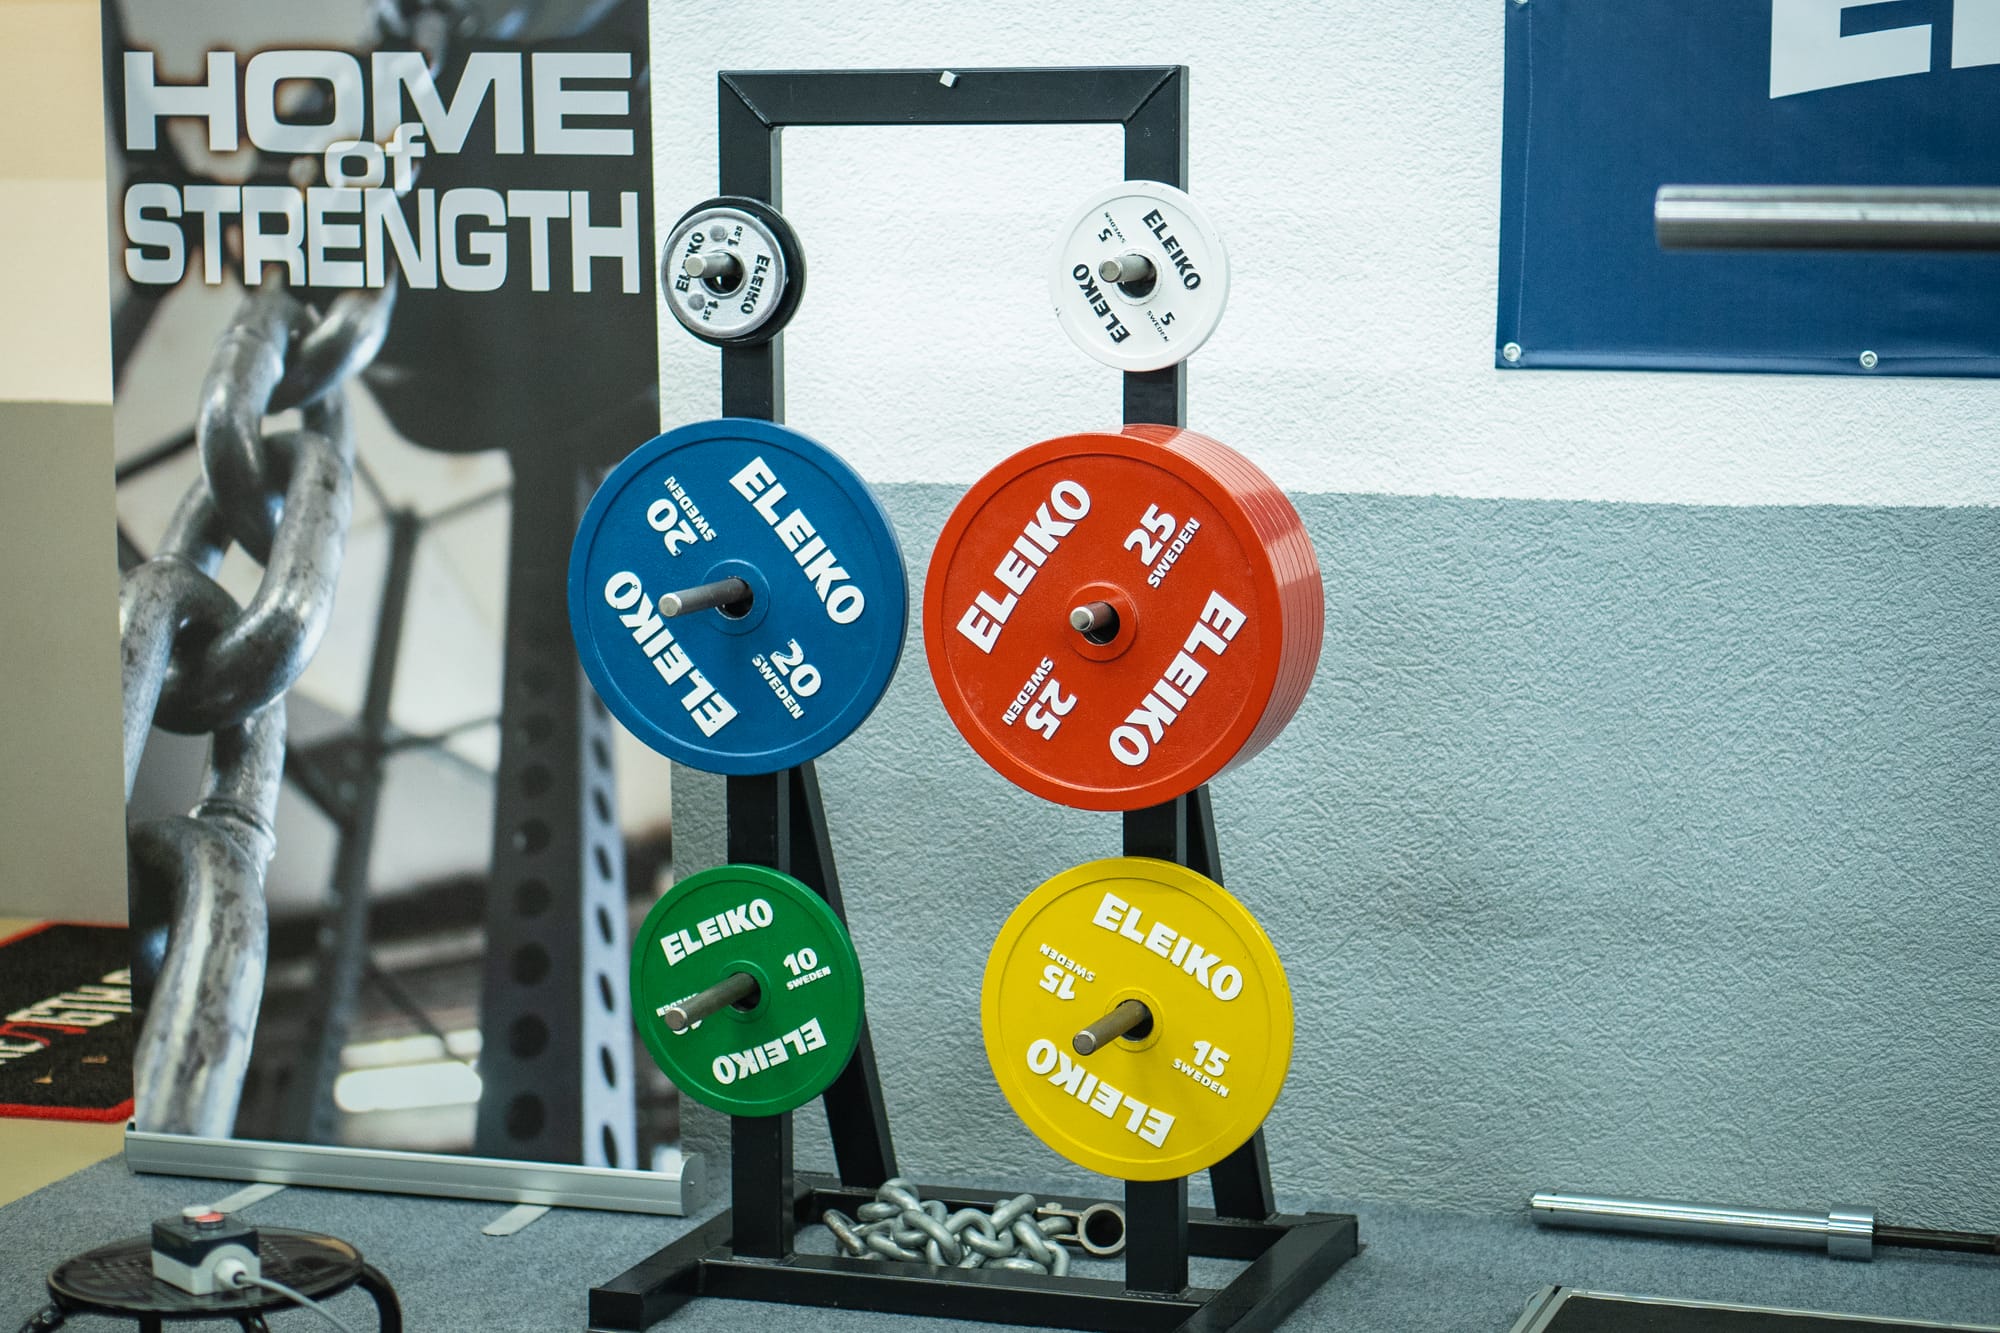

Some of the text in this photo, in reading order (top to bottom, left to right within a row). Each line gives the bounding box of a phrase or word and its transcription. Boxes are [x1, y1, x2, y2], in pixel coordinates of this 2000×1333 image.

[123, 50, 634, 155] HOME
[324, 122, 426, 191] of
[124, 182, 640, 294] STRENGTH
[1098, 228, 1113, 243] 5
[1104, 211, 1126, 244] SWEDEN
[1142, 208, 1202, 290] ELEIKO
[675, 232, 705, 292] ELKO
[740, 254, 771, 314] ELEIKO
[1072, 263, 1132, 344] ELEIKO
[1147, 310, 1169, 342] SWEDEN
[1160, 311, 1176, 326] 5
[646, 498, 699, 557] 20
[664, 475, 717, 543] SWEDEN
[728, 455, 865, 625] ELEIKO
[1123, 503, 1177, 567] 25
[956, 480, 1092, 654] ELEIKO
[1147, 517, 1201, 589] SWEDEN
[604, 570, 740, 738] ELEIKO
[751, 653, 805, 720] SWEDEN
[769, 638, 822, 697] 20
[1108, 590, 1247, 767] ELEIKO
[1002, 657, 1054, 726] SWEDEN
[1025, 678, 1078, 741] 25
[659, 898, 774, 967] ELEIKO
[783, 947, 818, 976] 10
[1039, 943, 1096, 983] SWEDEN
[1092, 892, 1244, 1001] ELEIKO
[786, 965, 832, 991] SWEDEN
[1039, 964, 1076, 1000] 15
[712, 1017, 828, 1085] ELEIKO
[1171, 1058, 1229, 1098] SWEDEN
[1192, 1040, 1231, 1077] 15
[1026, 1038, 1176, 1148] ELEIKO
